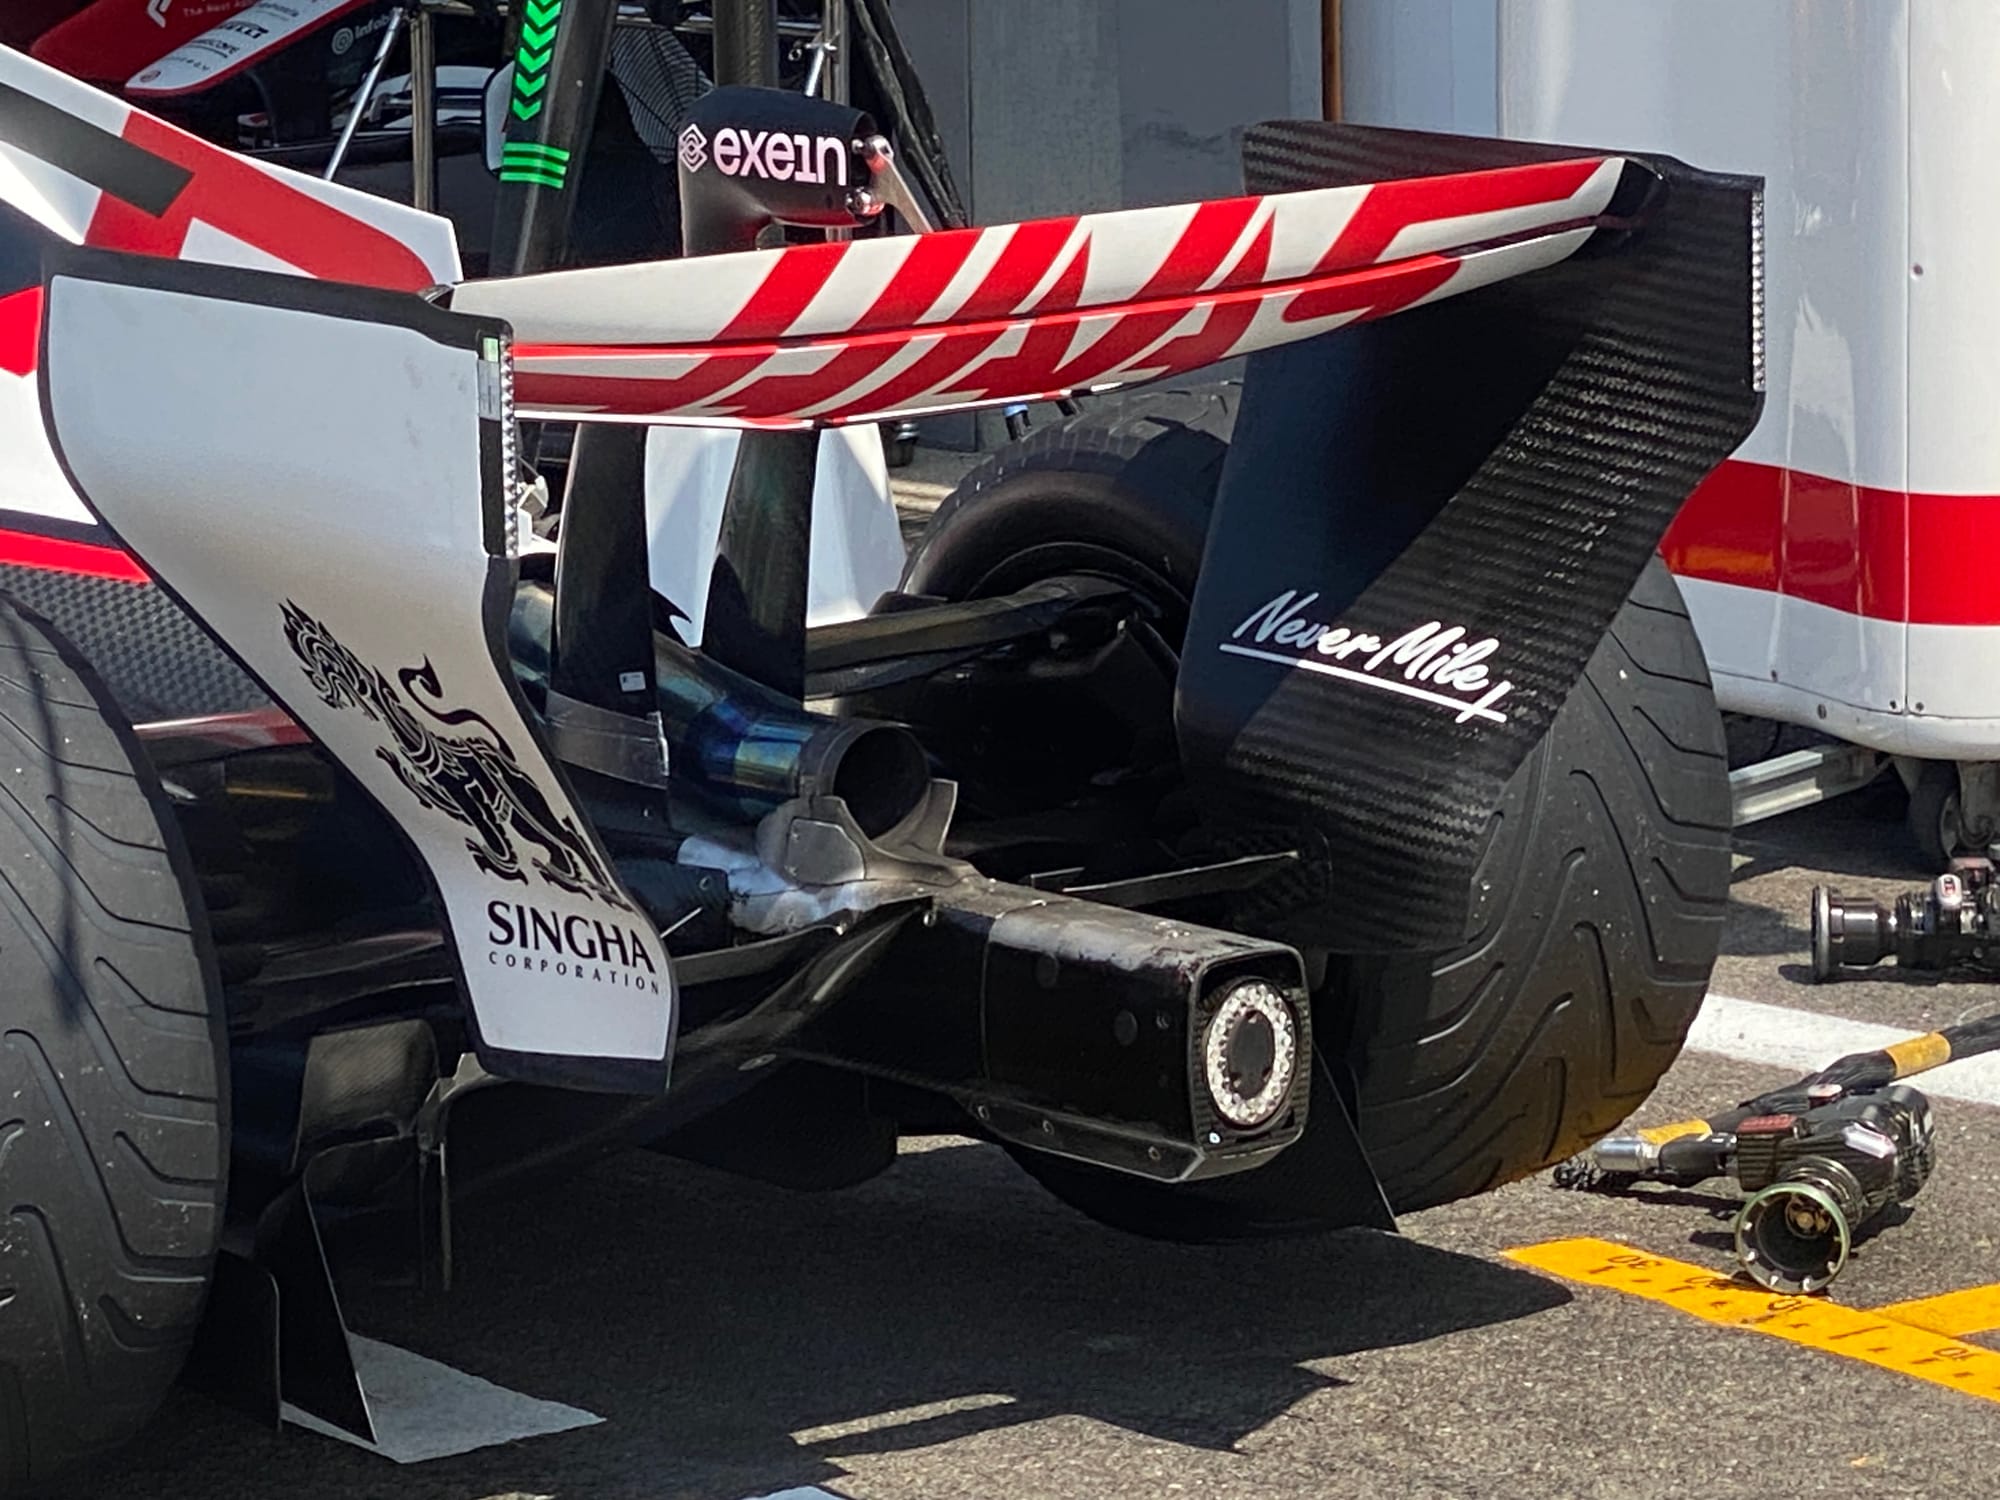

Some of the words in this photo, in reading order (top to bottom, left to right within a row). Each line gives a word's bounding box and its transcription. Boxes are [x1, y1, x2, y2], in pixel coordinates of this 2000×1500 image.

[713, 127, 847, 186] exein
[487, 900, 656, 974] SINGHA
[488, 951, 660, 995] CORPORATION
